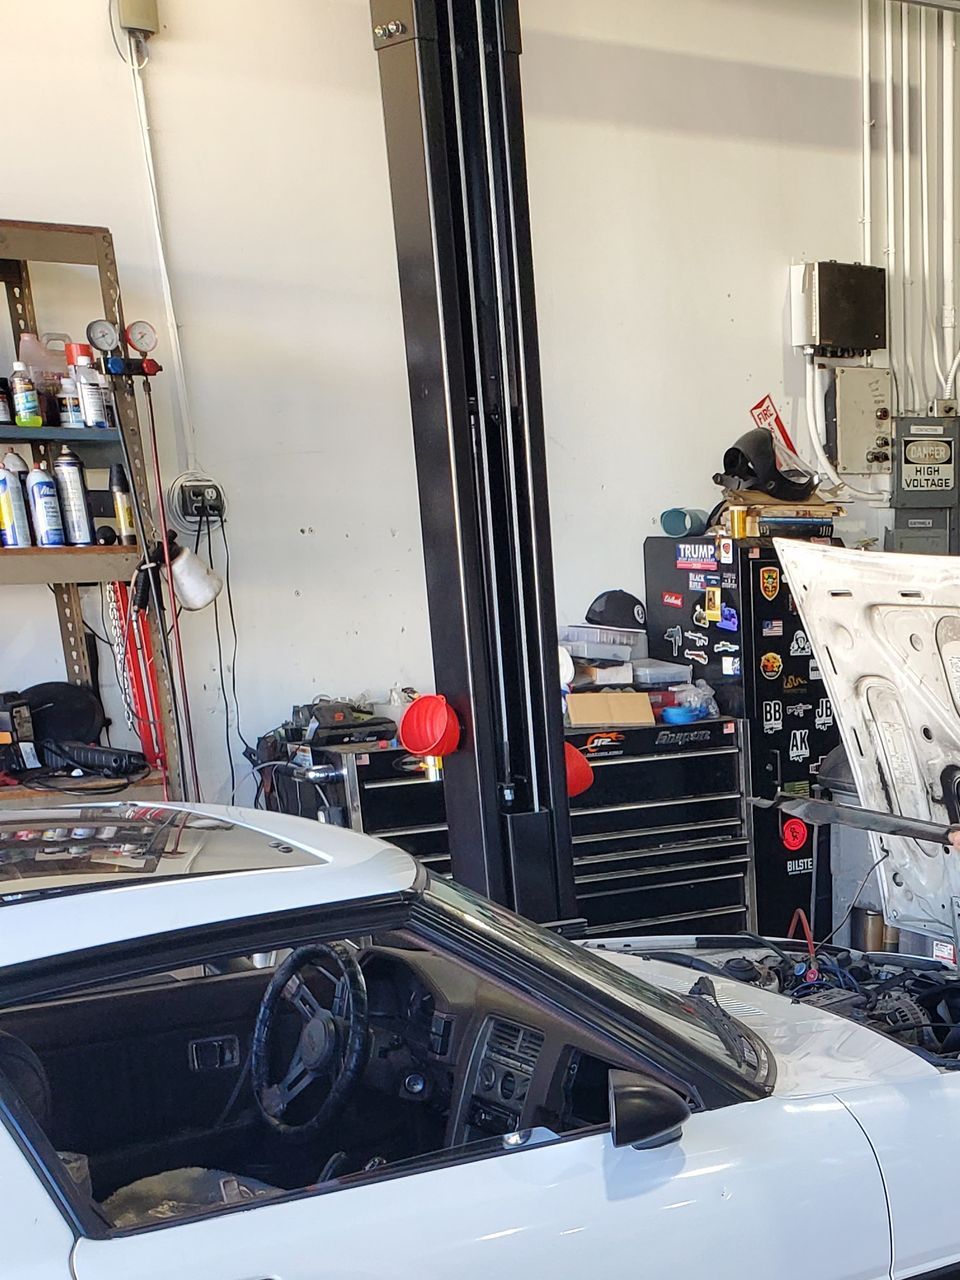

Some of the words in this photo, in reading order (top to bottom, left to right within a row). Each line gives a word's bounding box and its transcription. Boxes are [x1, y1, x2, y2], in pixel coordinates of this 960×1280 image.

[756, 404, 774, 426] FIRE
[910, 445, 946, 459] DANGER
[915, 466, 940, 476] HIGH
[904, 478, 951, 488] VOLTAGE
[678, 543, 715, 559] TRUMP
[763, 702, 781, 722] BB
[816, 699, 833, 718] JB
[790, 730, 808, 752] AK
